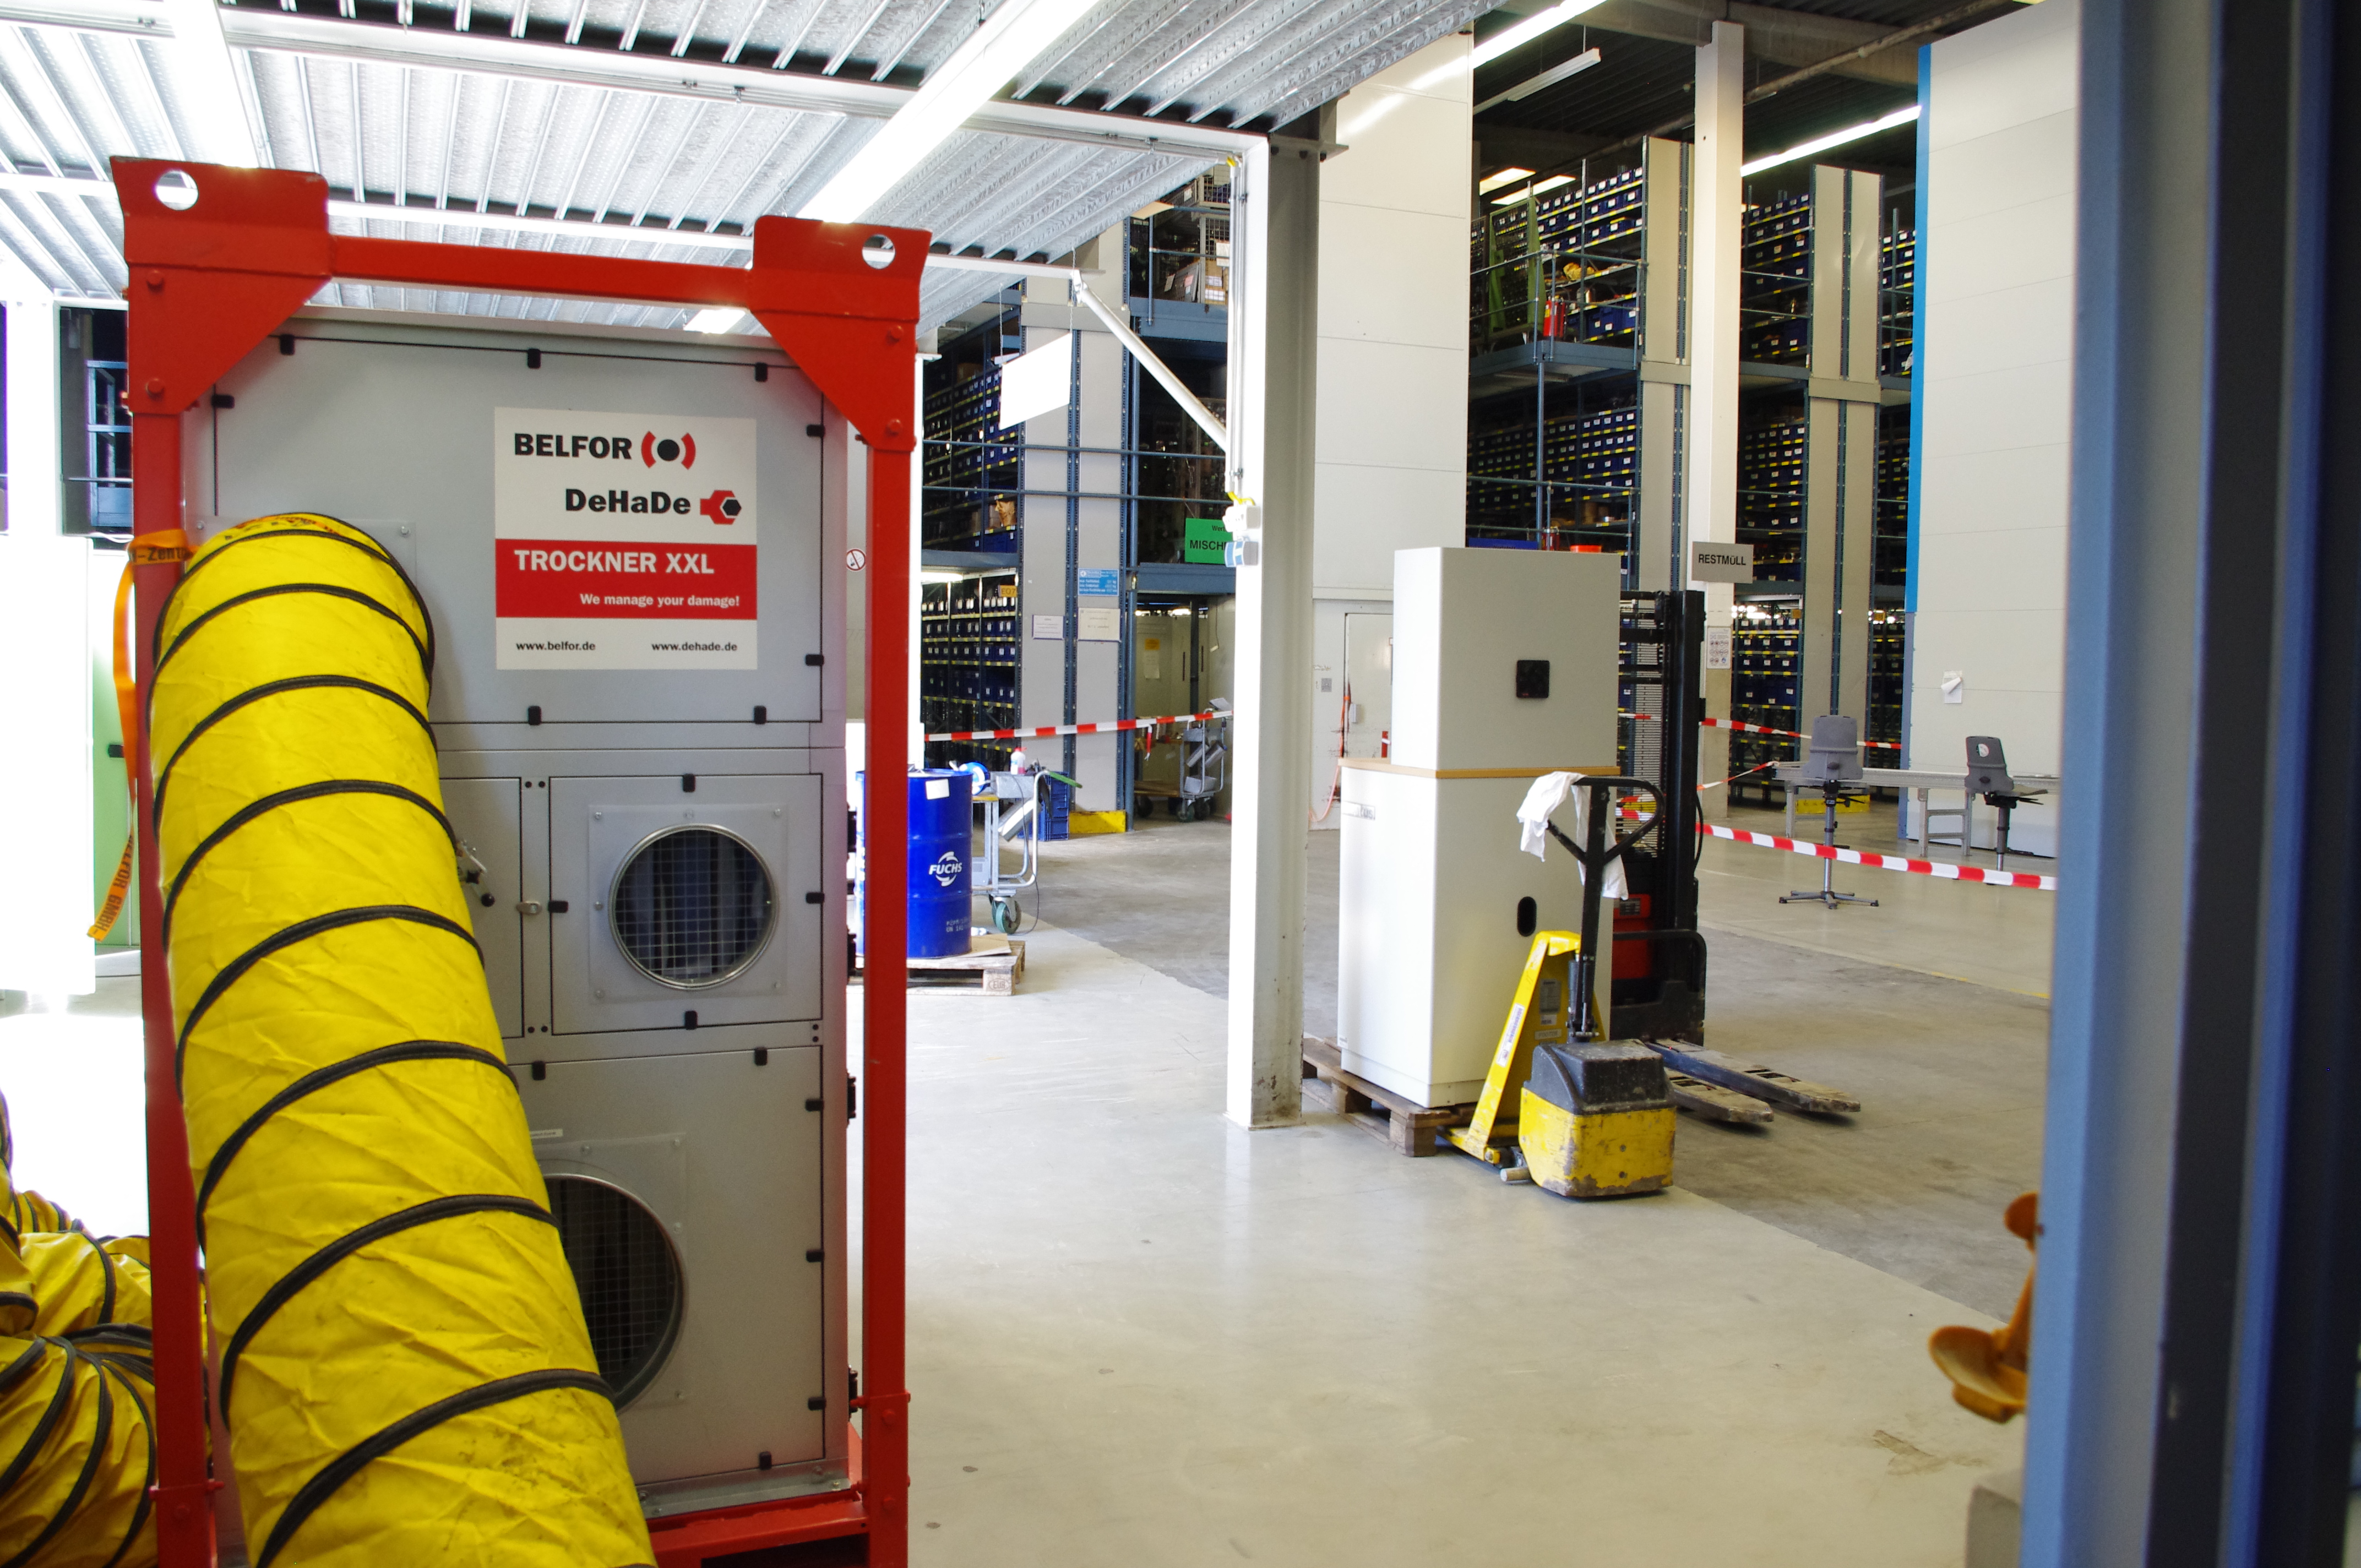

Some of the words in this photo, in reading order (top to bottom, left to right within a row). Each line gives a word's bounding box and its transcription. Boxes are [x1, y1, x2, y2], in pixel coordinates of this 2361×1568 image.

[514, 432, 633, 460] BELFOR
[565, 488, 691, 515] DeHaDe
[1190, 540, 1226, 551] MISCH
[514, 549, 657, 573] TROCKNER
[665, 552, 715, 574] XXL
[1698, 554, 1747, 566] RESTMÜLL
[580, 593, 601, 606] We
[603, 596, 654, 608] manage
[657, 596, 684, 608] your
[687, 595, 740, 608] damage!
[516, 640, 596, 651] www.belfor.de
[651, 641, 738, 652] www.dehade.de
[928, 862, 962, 875] FUCHS
